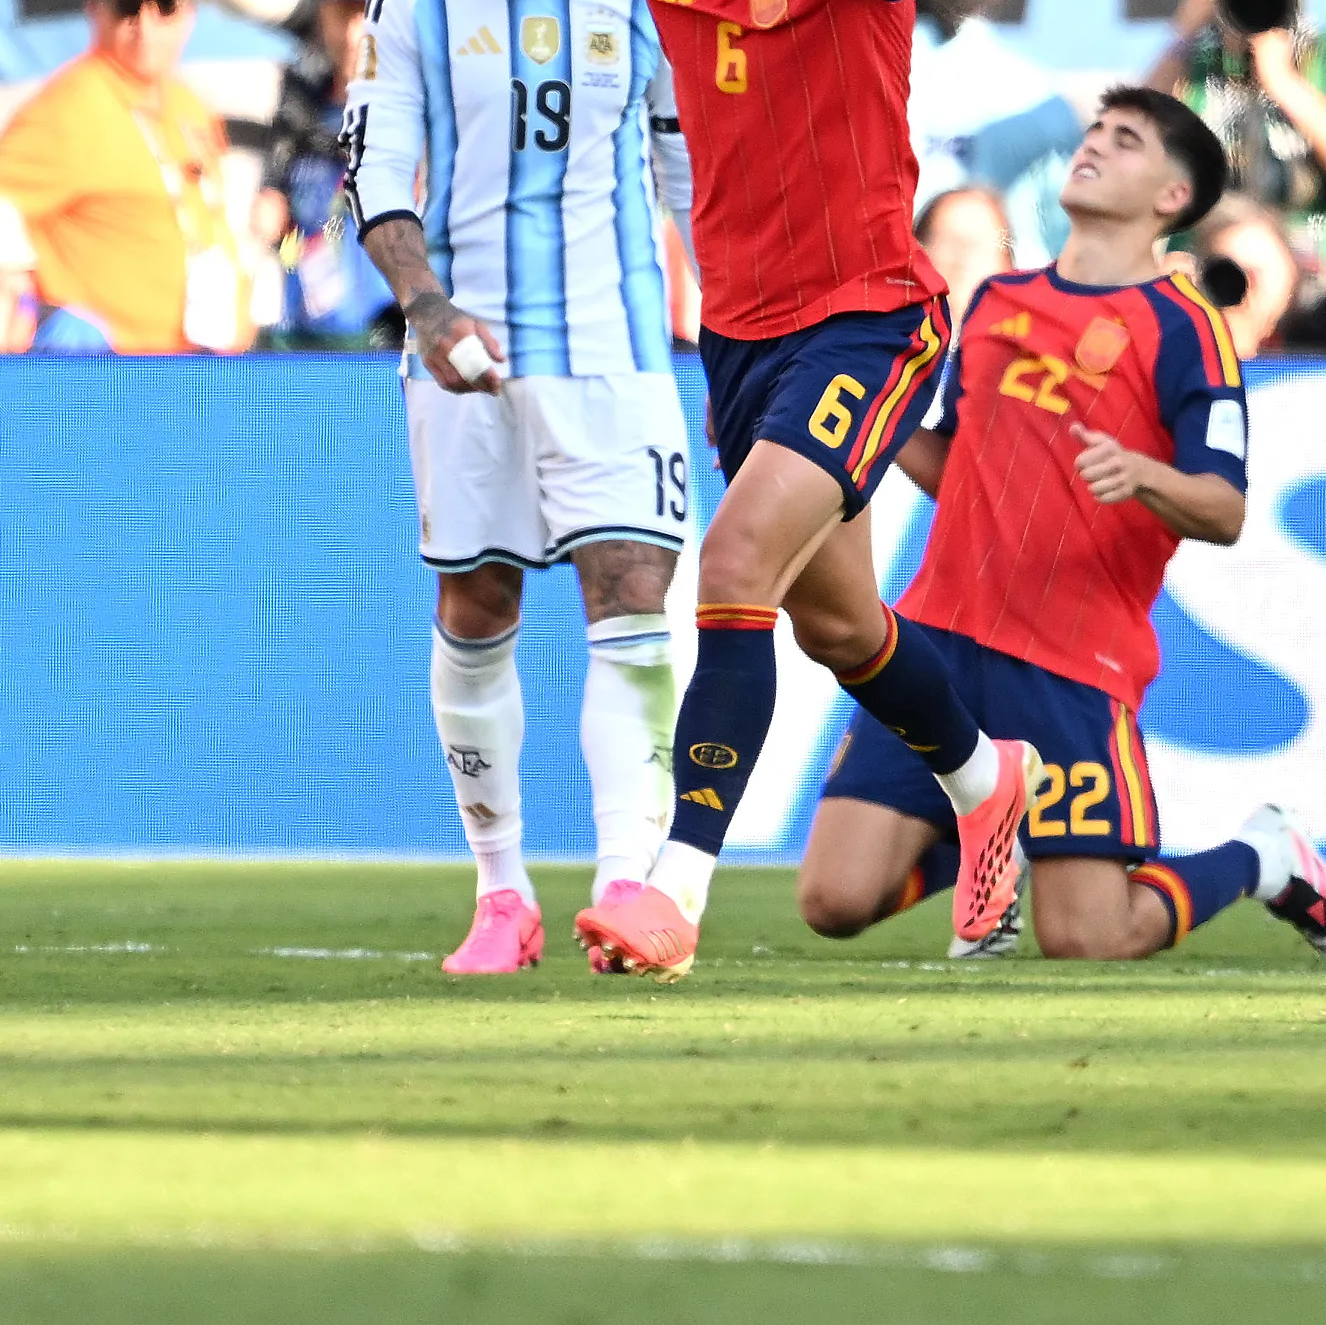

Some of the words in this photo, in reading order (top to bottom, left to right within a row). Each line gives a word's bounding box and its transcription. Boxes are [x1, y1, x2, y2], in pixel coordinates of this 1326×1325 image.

[716, 24, 748, 94] 6
[510, 78, 571, 152] 19
[809, 374, 866, 449] 6
[998, 355, 1071, 415] 22
[648, 447, 686, 522] 19
[1028, 762, 1110, 837] 22
